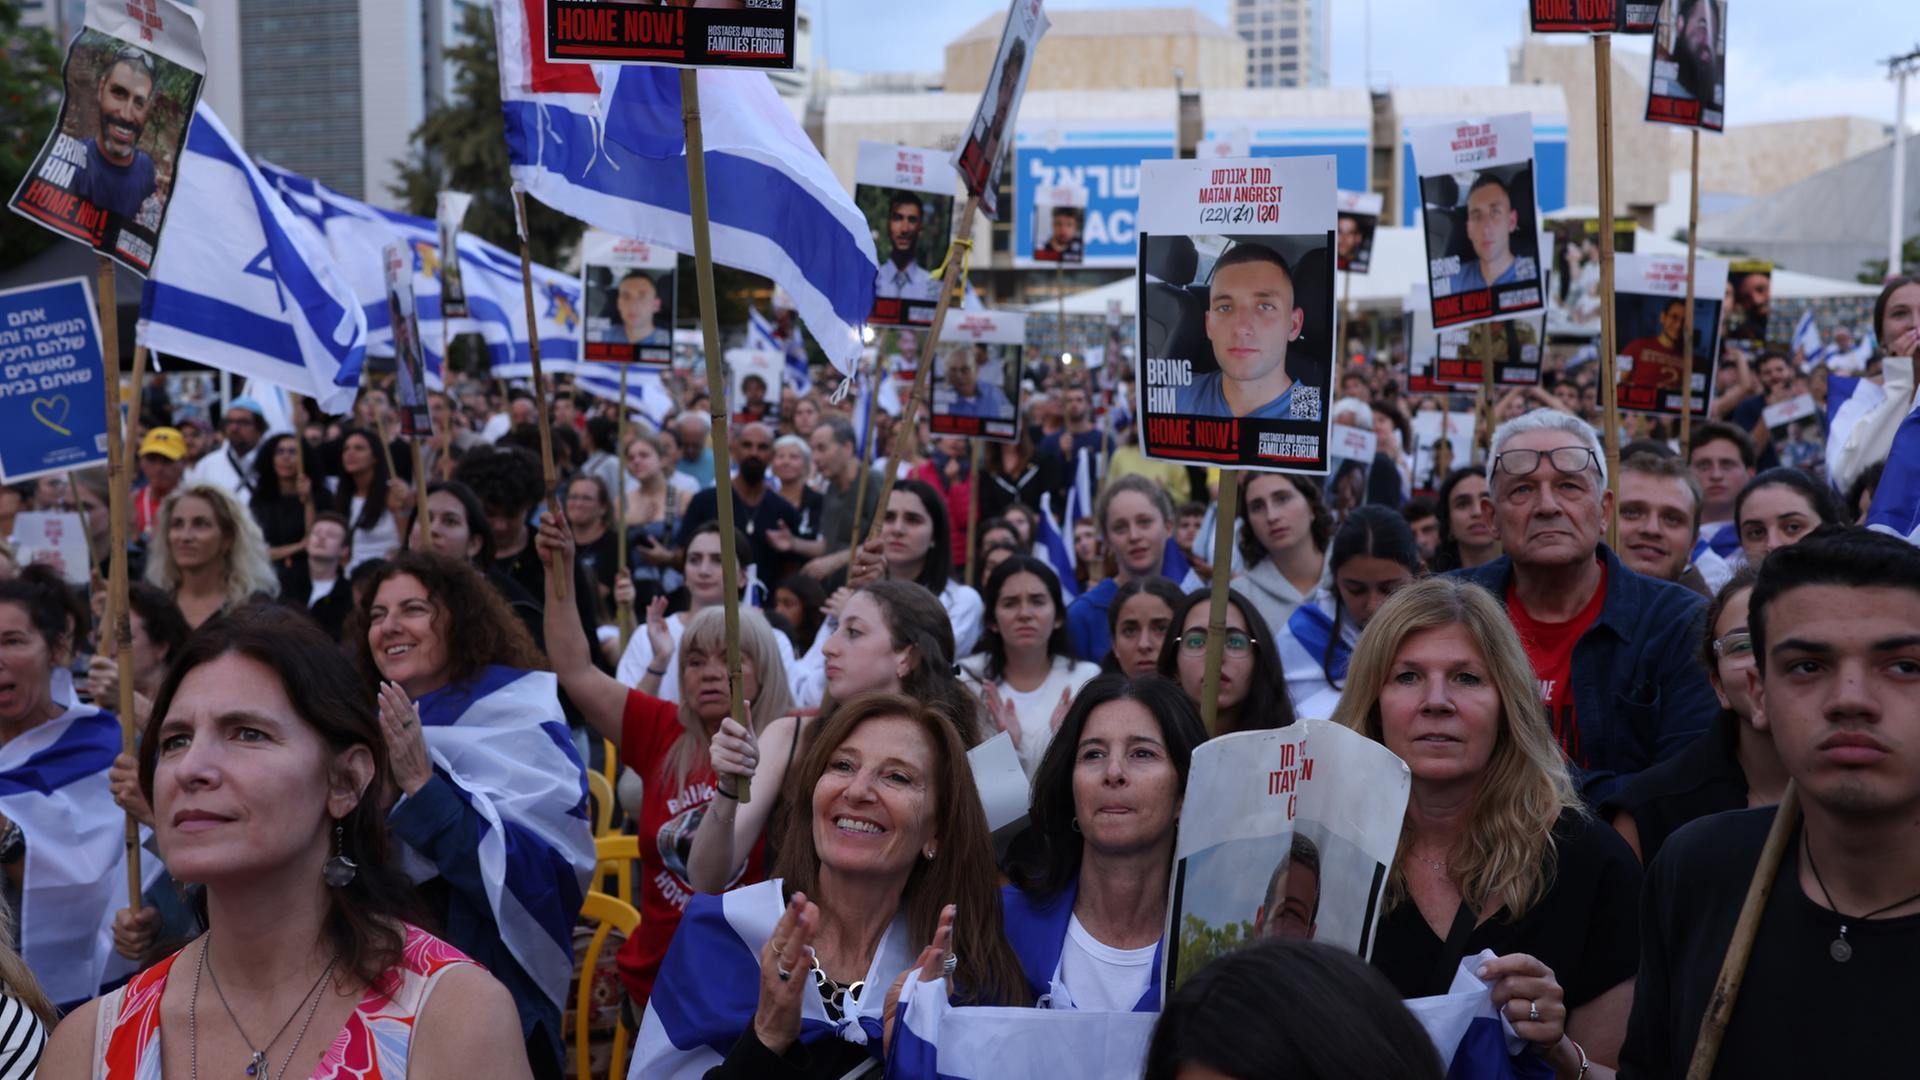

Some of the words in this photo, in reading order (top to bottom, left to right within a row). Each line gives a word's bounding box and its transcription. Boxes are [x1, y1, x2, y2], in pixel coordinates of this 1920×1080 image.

[557, 7, 618, 42] HOME
[623, 9, 685, 46] NOW!
[707, 24, 741, 38] HOSTAGES
[741, 26, 755, 39] AND
[755, 27, 785, 41] MISSING
[707, 36, 749, 53] FAMILIES
[750, 38, 785, 55] FORUM
[38, 156, 77, 189] HIM
[1251, 167, 1272, 187] מתן
[24, 179, 79, 220] HOME
[1198, 187, 1232, 204] MATAN
[1233, 185, 1283, 204] ANGREST
[7, 307, 47, 328] אתם
[23, 317, 87, 341] הנשימה
[36, 335, 86, 357] שלהם
[5, 354, 76, 379] מאושרים
[1147, 358, 1193, 387] BRING
[40, 367, 92, 391] שאתם
[1147, 386, 1177, 414] HIM
[1147, 417, 1191, 446] HOME
[1195, 417, 1240, 450] NOW!
[1258, 442, 1291, 456] FAMILIES
[1292, 444, 1320, 459] FORUM
[1268, 769, 1298, 796] ITAY
